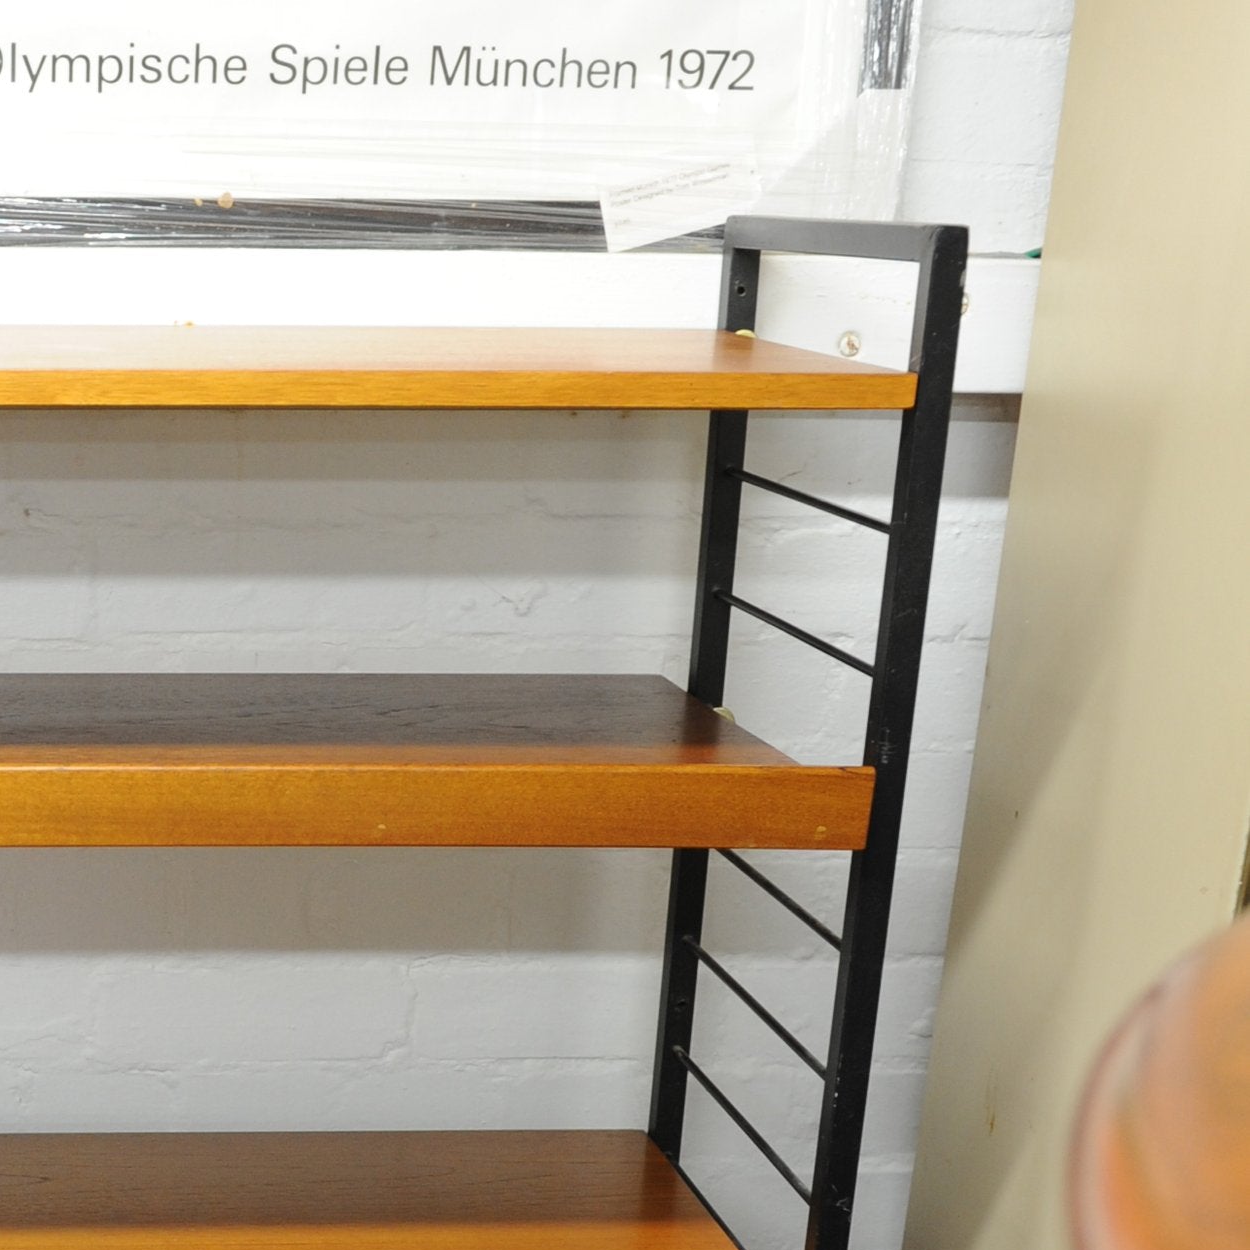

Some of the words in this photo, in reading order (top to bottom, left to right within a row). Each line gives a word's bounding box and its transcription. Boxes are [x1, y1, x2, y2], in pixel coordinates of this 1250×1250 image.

[269, 44, 408, 94] Spiele
[429, 45, 637, 88] München
[660, 49, 755, 90] 1972
